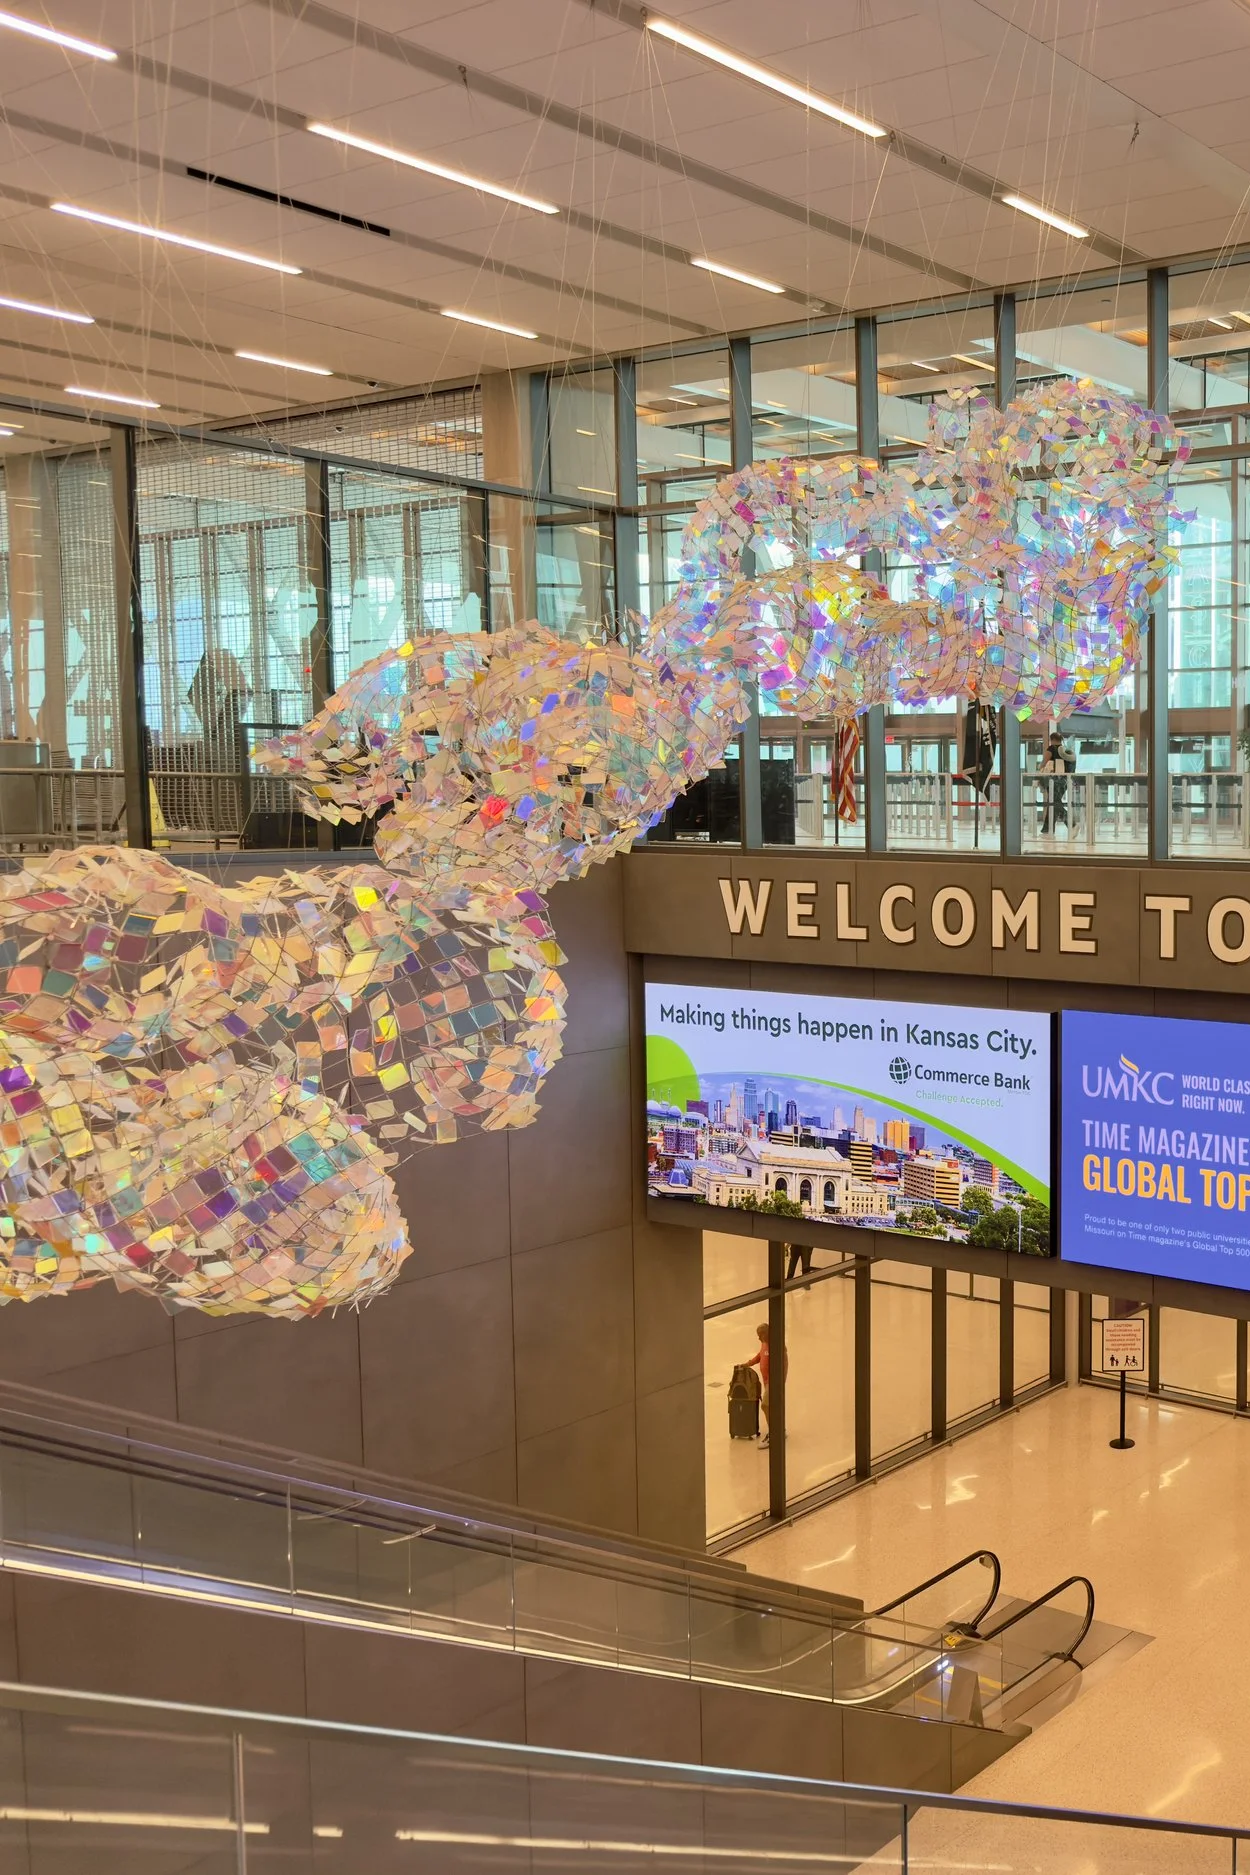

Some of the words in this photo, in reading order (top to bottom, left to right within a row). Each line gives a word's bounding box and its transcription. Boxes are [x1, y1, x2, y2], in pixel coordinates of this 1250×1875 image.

[717, 876, 1098, 955] WELCOME
[660, 1003, 725, 1032] Making
[731, 1007, 791, 1037] things
[798, 1012, 873, 1042] happen
[881, 1018, 898, 1042] in
[906, 1023, 979, 1050] Kansas
[987, 1029, 1037, 1059] City.
[914, 1064, 989, 1086] Commerce
[994, 1072, 1030, 1090] Bank
[1082, 1054, 1175, 1106] UMKC
[1182, 1074, 1220, 1092] WORLD
[916, 1090, 958, 1103] Challenge
[960, 1095, 1004, 1108] Accepted.
[1182, 1094, 1215, 1111] RIGHT
[1218, 1098, 1245, 1114] NOW.
[1082, 1119, 1131, 1151] TIME
[1083, 1154, 1192, 1204] GLOBAL
[1084, 1213, 1106, 1224] Proud
[1108, 1217, 1116, 1226] to
[1117, 1218, 1127, 1227] be
[1128, 1222, 1143, 1230] one
[1144, 1222, 1153, 1231] of
[1154, 1225, 1169, 1236] only
[1171, 1226, 1186, 1236] two
[1187, 1230, 1211, 1241] public
[1084, 1224, 1115, 1237] Missouri
[1116, 1230, 1127, 1238] on
[1128, 1230, 1147, 1241] Time
[1148, 1234, 1191, 1248] magazine's
[1192, 1239, 1218, 1252] Global
[1218, 1244, 1234, 1256] Top
[1235, 1247, 1250, 1257] 500
